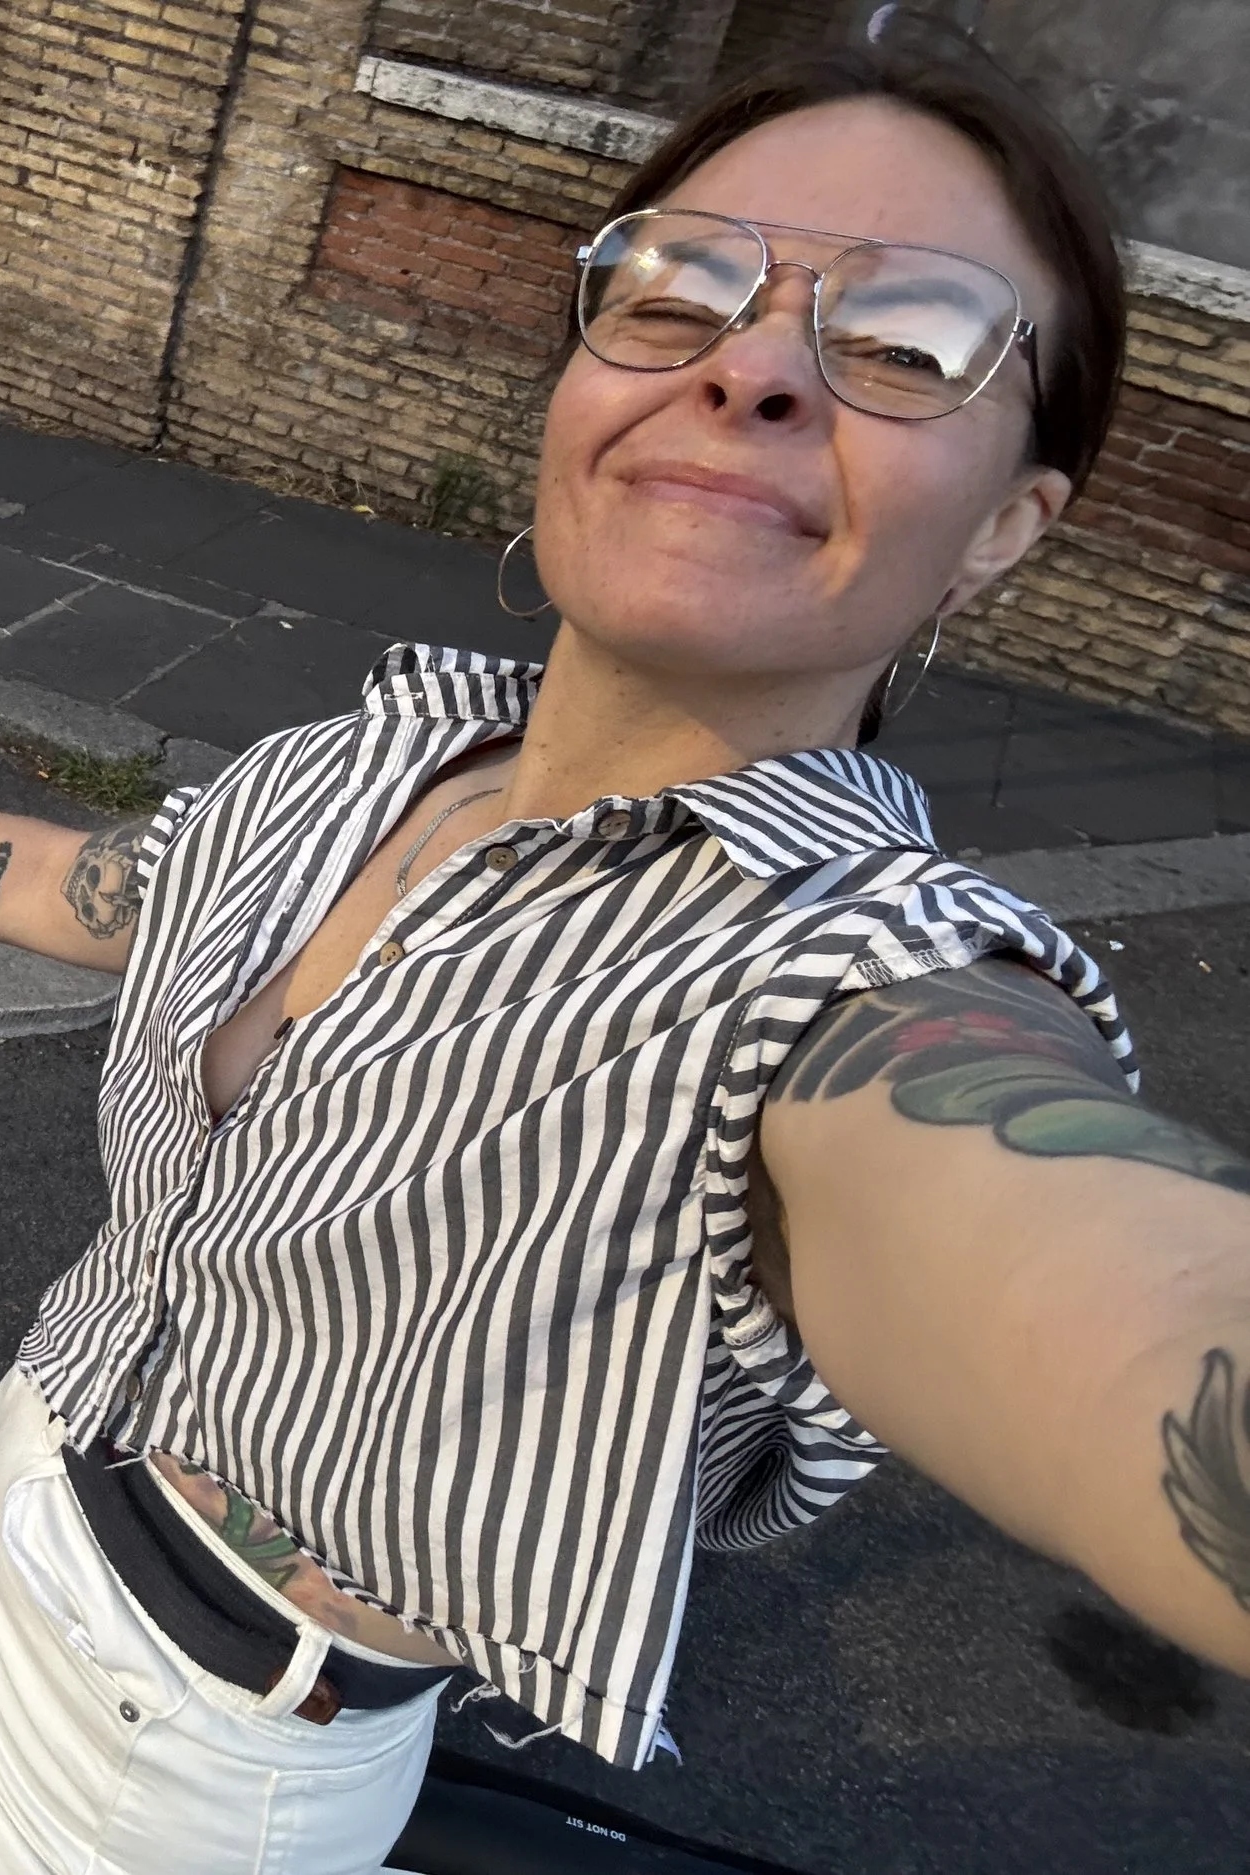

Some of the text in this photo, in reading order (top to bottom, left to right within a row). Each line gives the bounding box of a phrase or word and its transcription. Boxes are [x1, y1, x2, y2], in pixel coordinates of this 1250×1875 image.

[566, 1816, 626, 1842] DO NOT SIT
